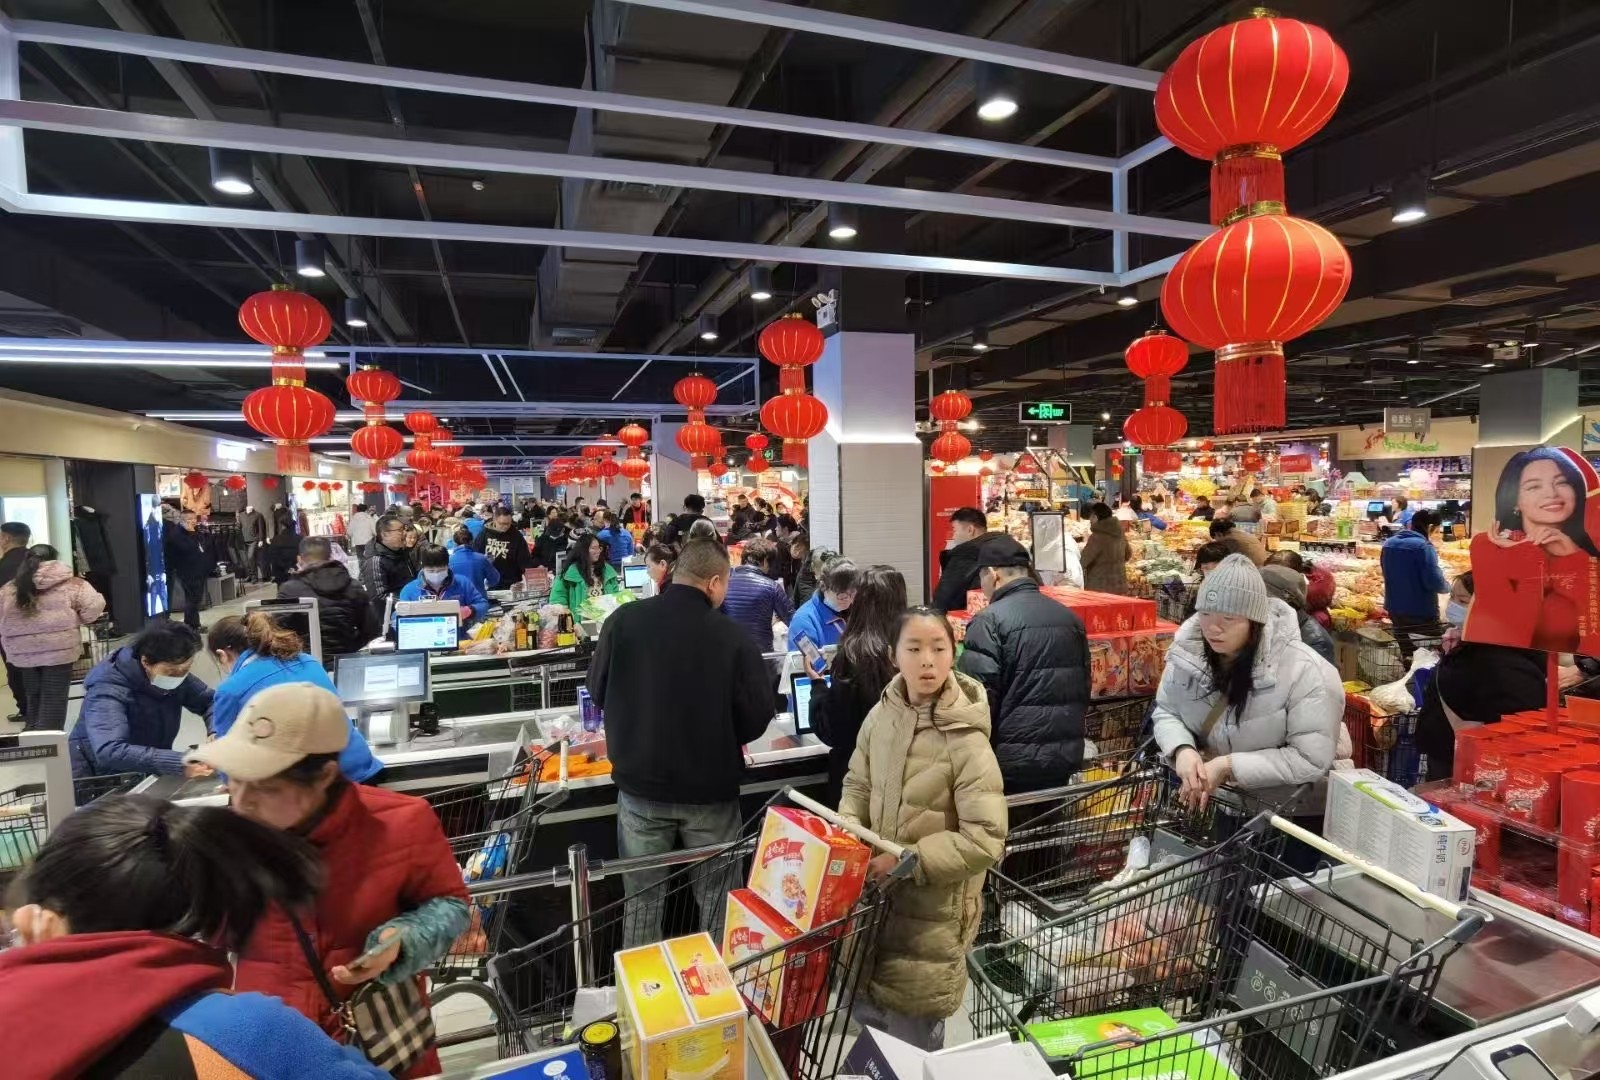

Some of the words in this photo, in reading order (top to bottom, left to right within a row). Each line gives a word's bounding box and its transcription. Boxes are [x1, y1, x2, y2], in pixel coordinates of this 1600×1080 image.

[765, 842, 785, 858] 娃哈哈
[1436, 834, 1448, 864] 纯牛奶
